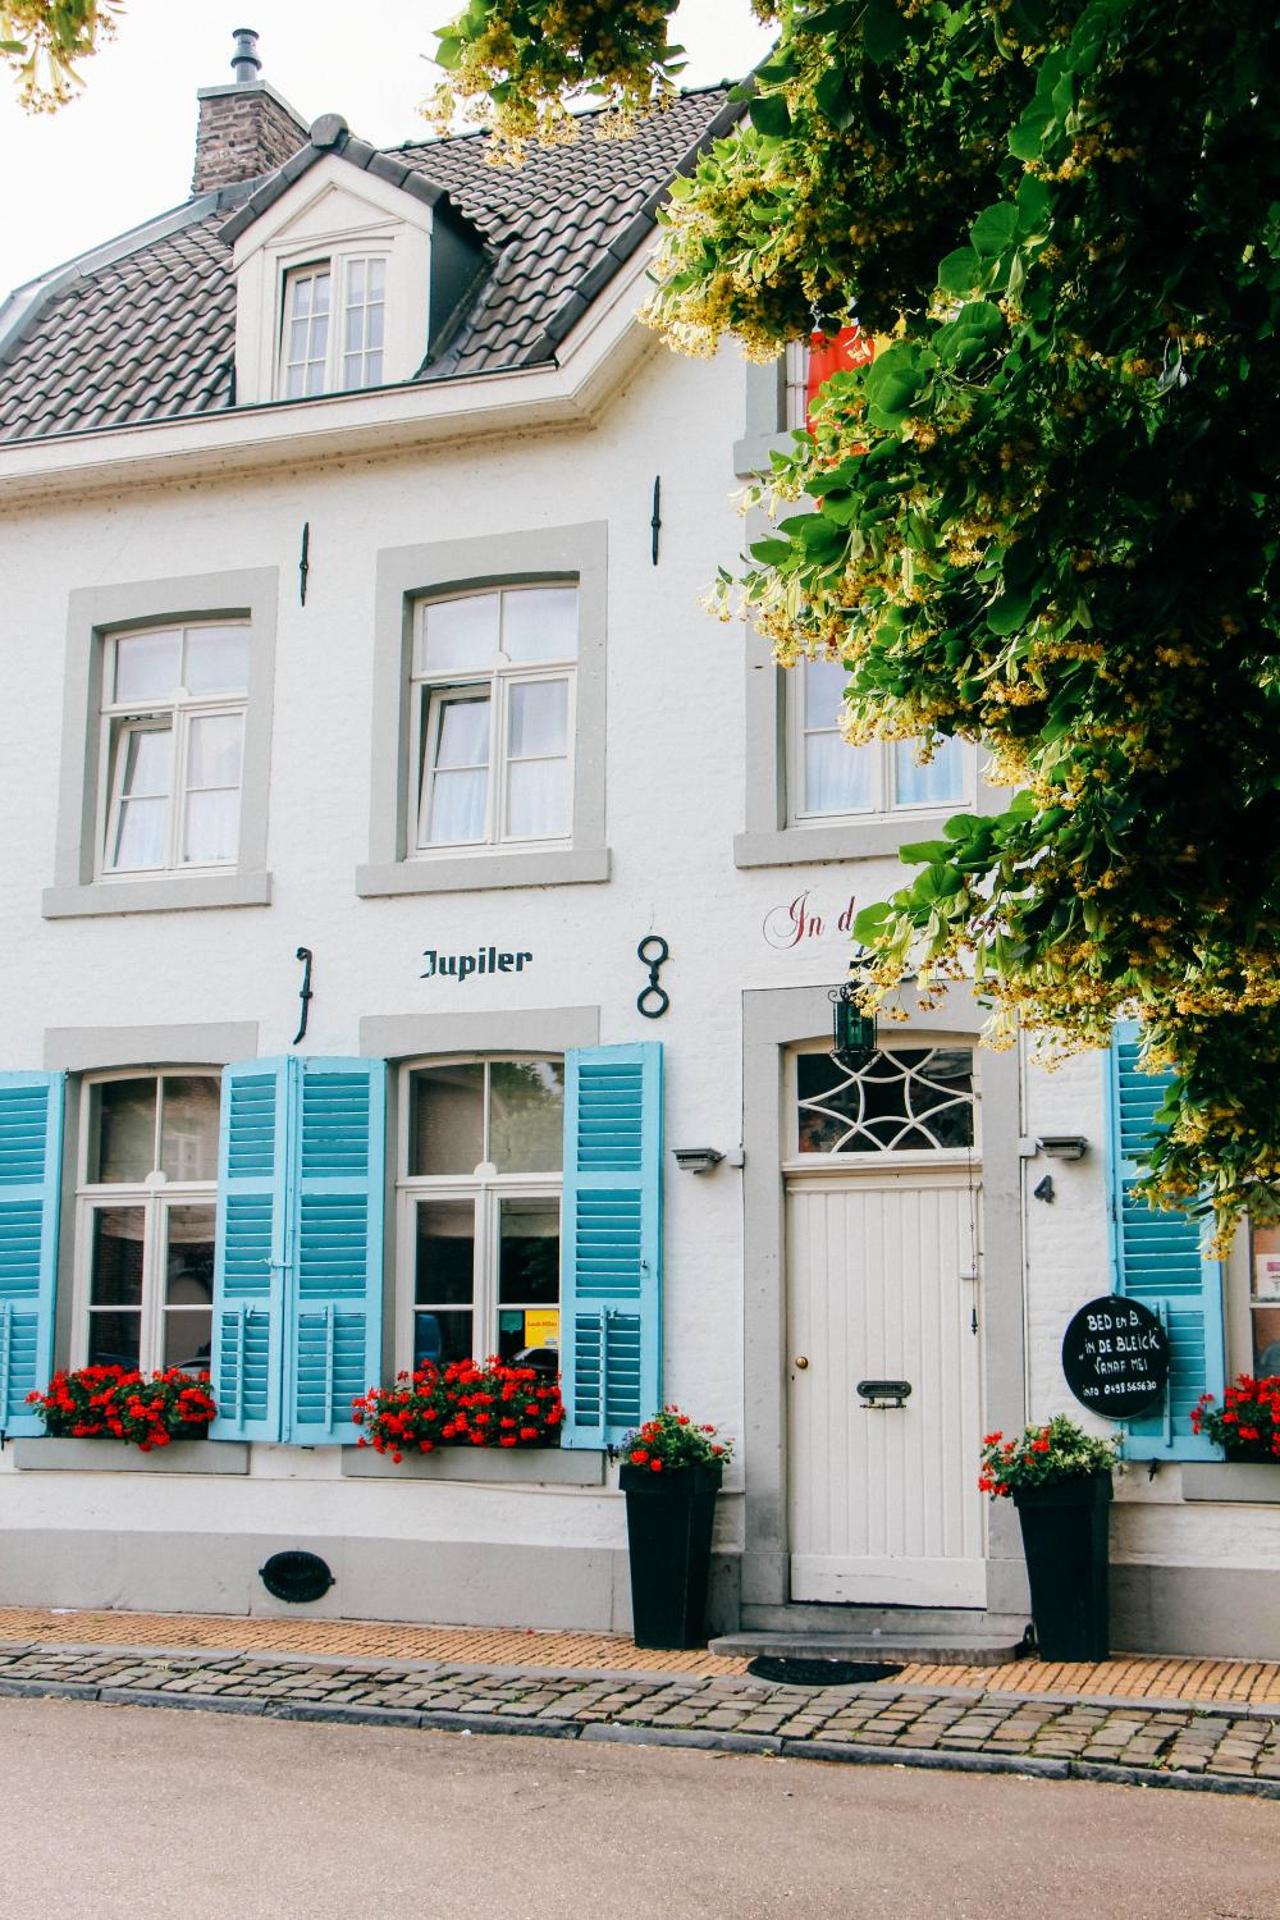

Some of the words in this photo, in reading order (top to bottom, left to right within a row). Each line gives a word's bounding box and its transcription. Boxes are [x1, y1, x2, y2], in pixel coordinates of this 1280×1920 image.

[763, 889, 825, 950] In
[838, 895, 855, 932] d
[419, 946, 533, 982] Jupiler
[1033, 1174, 1056, 1204] 4
[1087, 1313, 1113, 1332] BED
[1099, 1339, 1113, 1354] DE
[1093, 1356, 1127, 1376] VANAF
[1130, 1357, 1149, 1372] MEI
